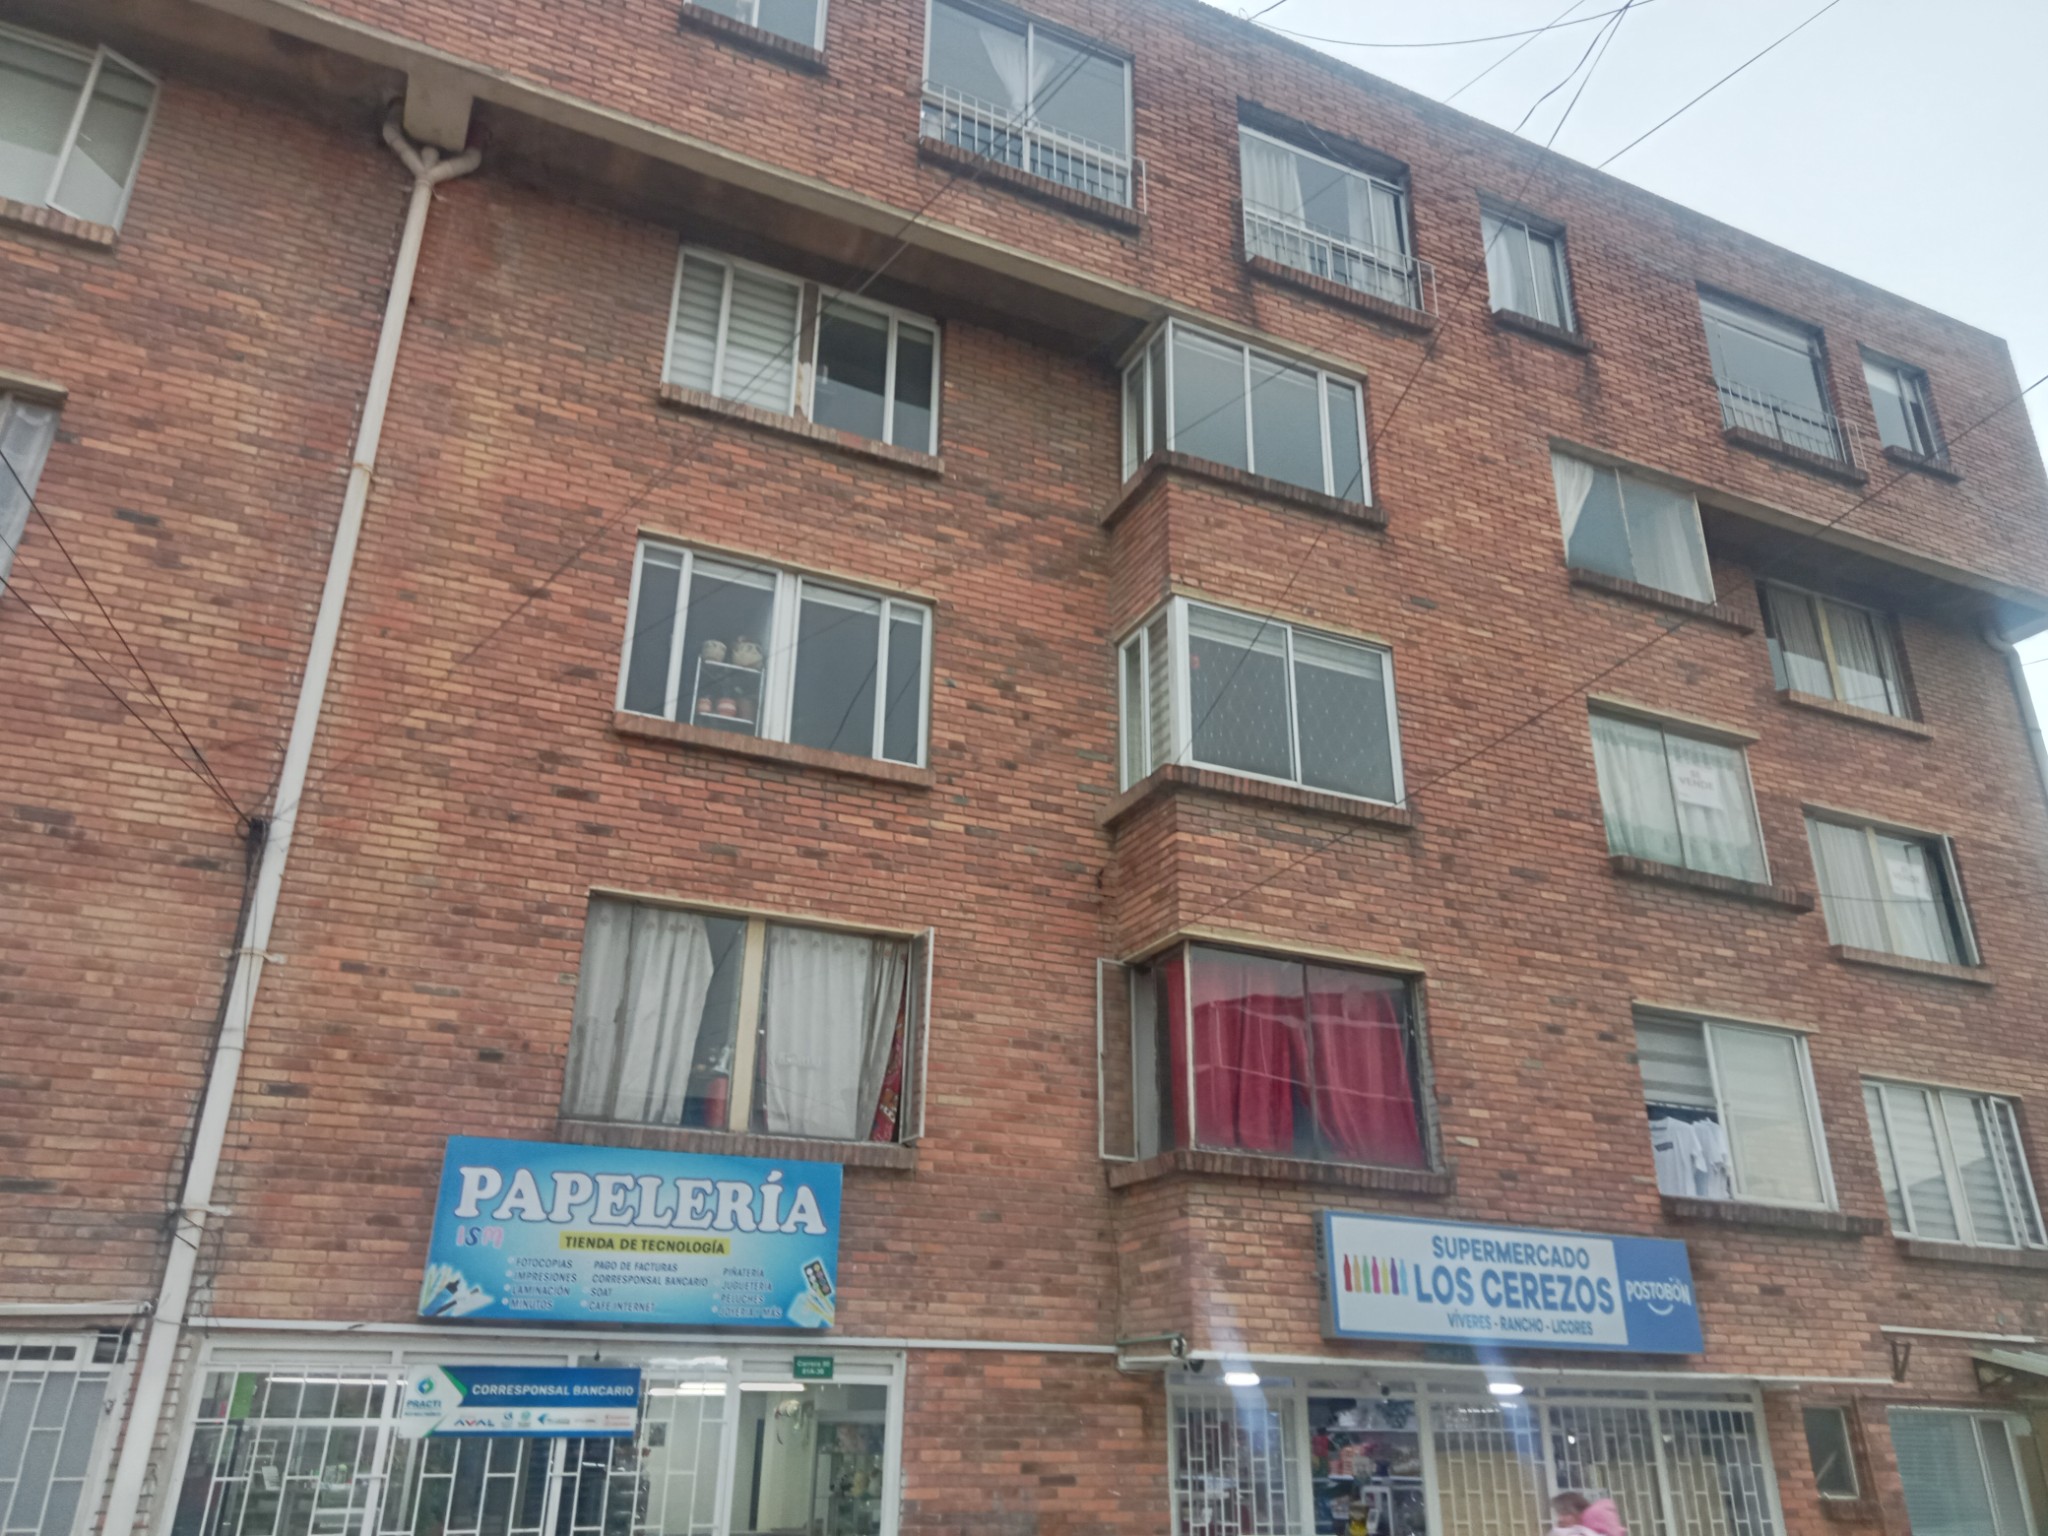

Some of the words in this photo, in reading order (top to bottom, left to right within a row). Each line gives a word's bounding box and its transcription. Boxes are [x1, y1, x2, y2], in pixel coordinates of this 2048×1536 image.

[454, 1166, 828, 1235] PAPELERÍA
[565, 1236, 615, 1251] TIENDA
[620, 1238, 638, 1252] DE
[641, 1239, 725, 1255] TECNOLOGÍA
[1432, 1235, 1590, 1270] SUPERMERCADO
[516, 1257, 573, 1269] FOTOCOPIAS
[593, 1260, 617, 1270] PAGO
[620, 1261, 631, 1271] DE
[634, 1262, 678, 1273] FACTURAS
[513, 1271, 577, 1283] IMPRESIONES
[592, 1274, 661, 1285] CORRESPONSAL
[665, 1276, 708, 1287] BANCARIO
[1413, 1263, 1475, 1306] LOS
[1481, 1268, 1616, 1315] CEREZOS
[1500, 1316, 1543, 1333] RANCHO
[1551, 1319, 1593, 1336] LICORES
[472, 1384, 570, 1396] CORRESPONSAL
[573, 1385, 634, 1397] BANCARIO
